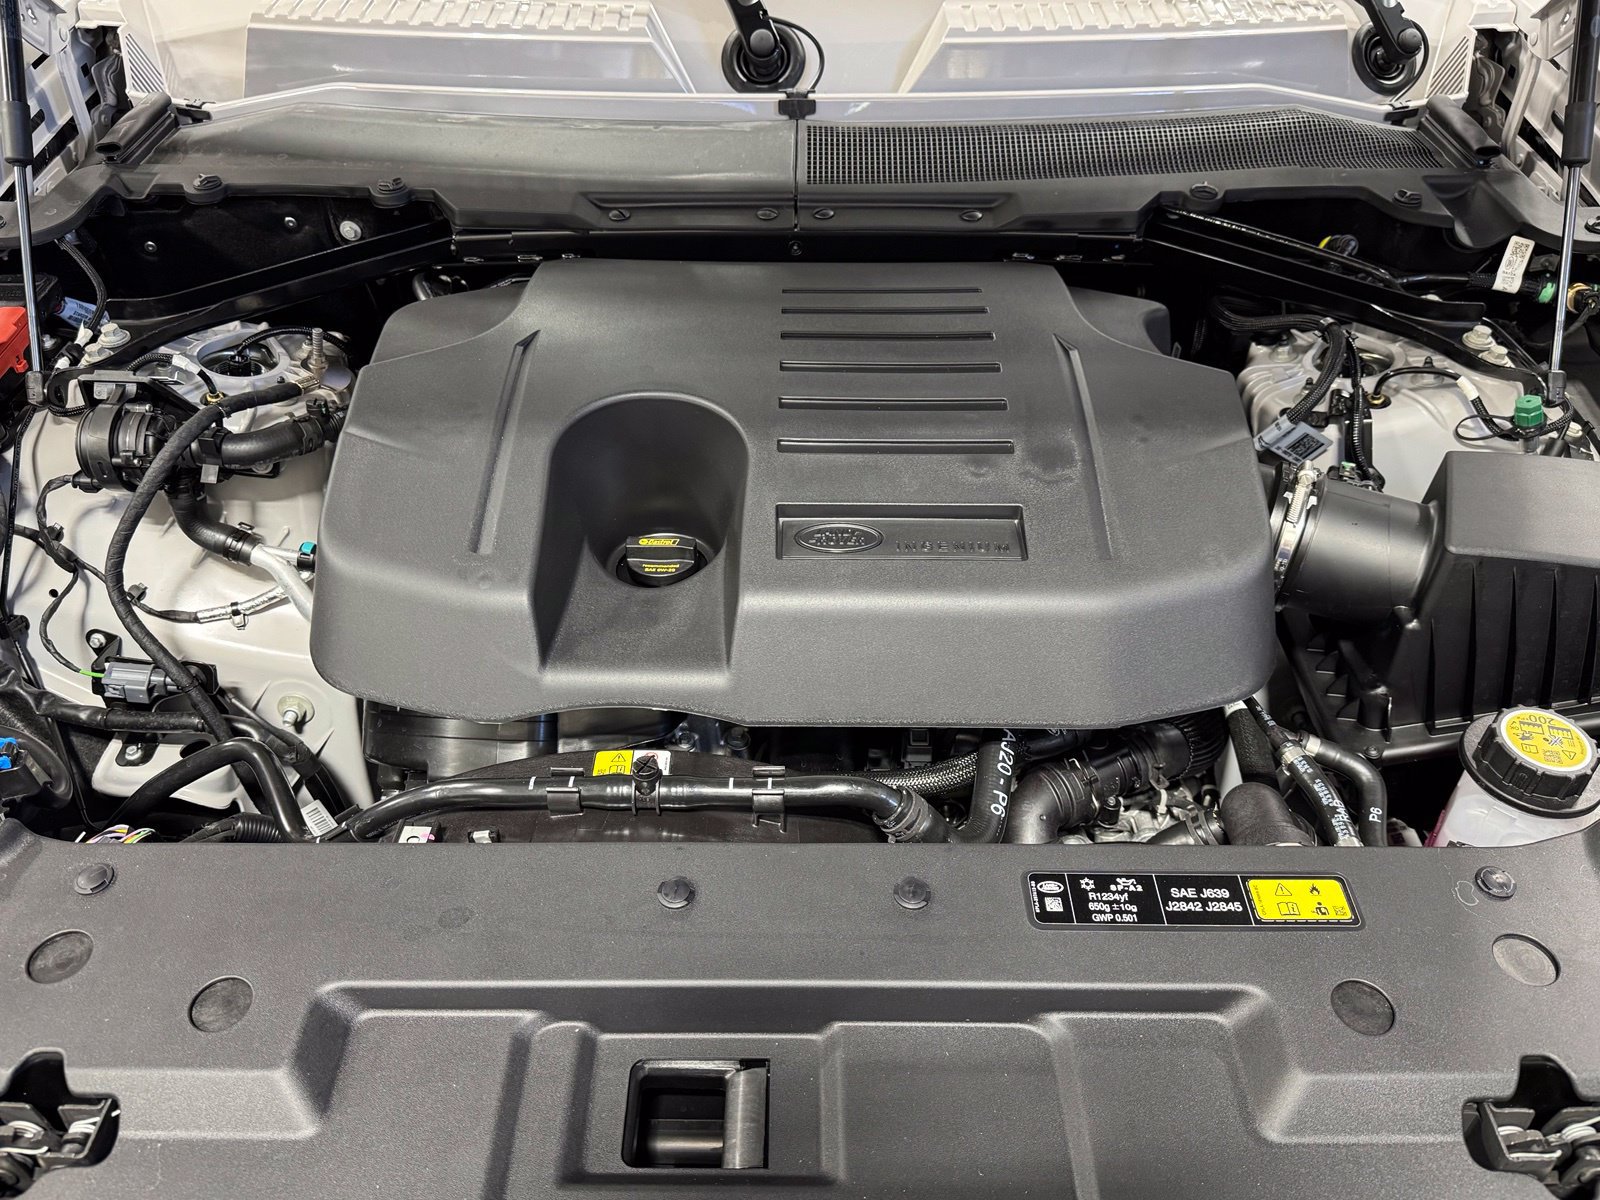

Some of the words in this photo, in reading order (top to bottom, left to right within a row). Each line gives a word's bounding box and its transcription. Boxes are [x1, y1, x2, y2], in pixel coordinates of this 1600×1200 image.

[895, 540, 1012, 553] INGENIUM
[1529, 715, 1557, 726] 200
[997, 728, 1016, 776] AJ20
[990, 790, 1008, 818] P6
[1368, 806, 1383, 823] P6
[1088, 892, 1129, 903] R1234yf
[1170, 888, 1198, 899] SAE
[1200, 888, 1230, 899] J639
[1088, 902, 1111, 912] 650g
[1112, 902, 1138, 912] ±10g
[1165, 901, 1203, 912] J2842
[1205, 901, 1243, 912] J2845
[1092, 913, 1114, 922] GWP
[1115, 913, 1138, 922] 0.501
